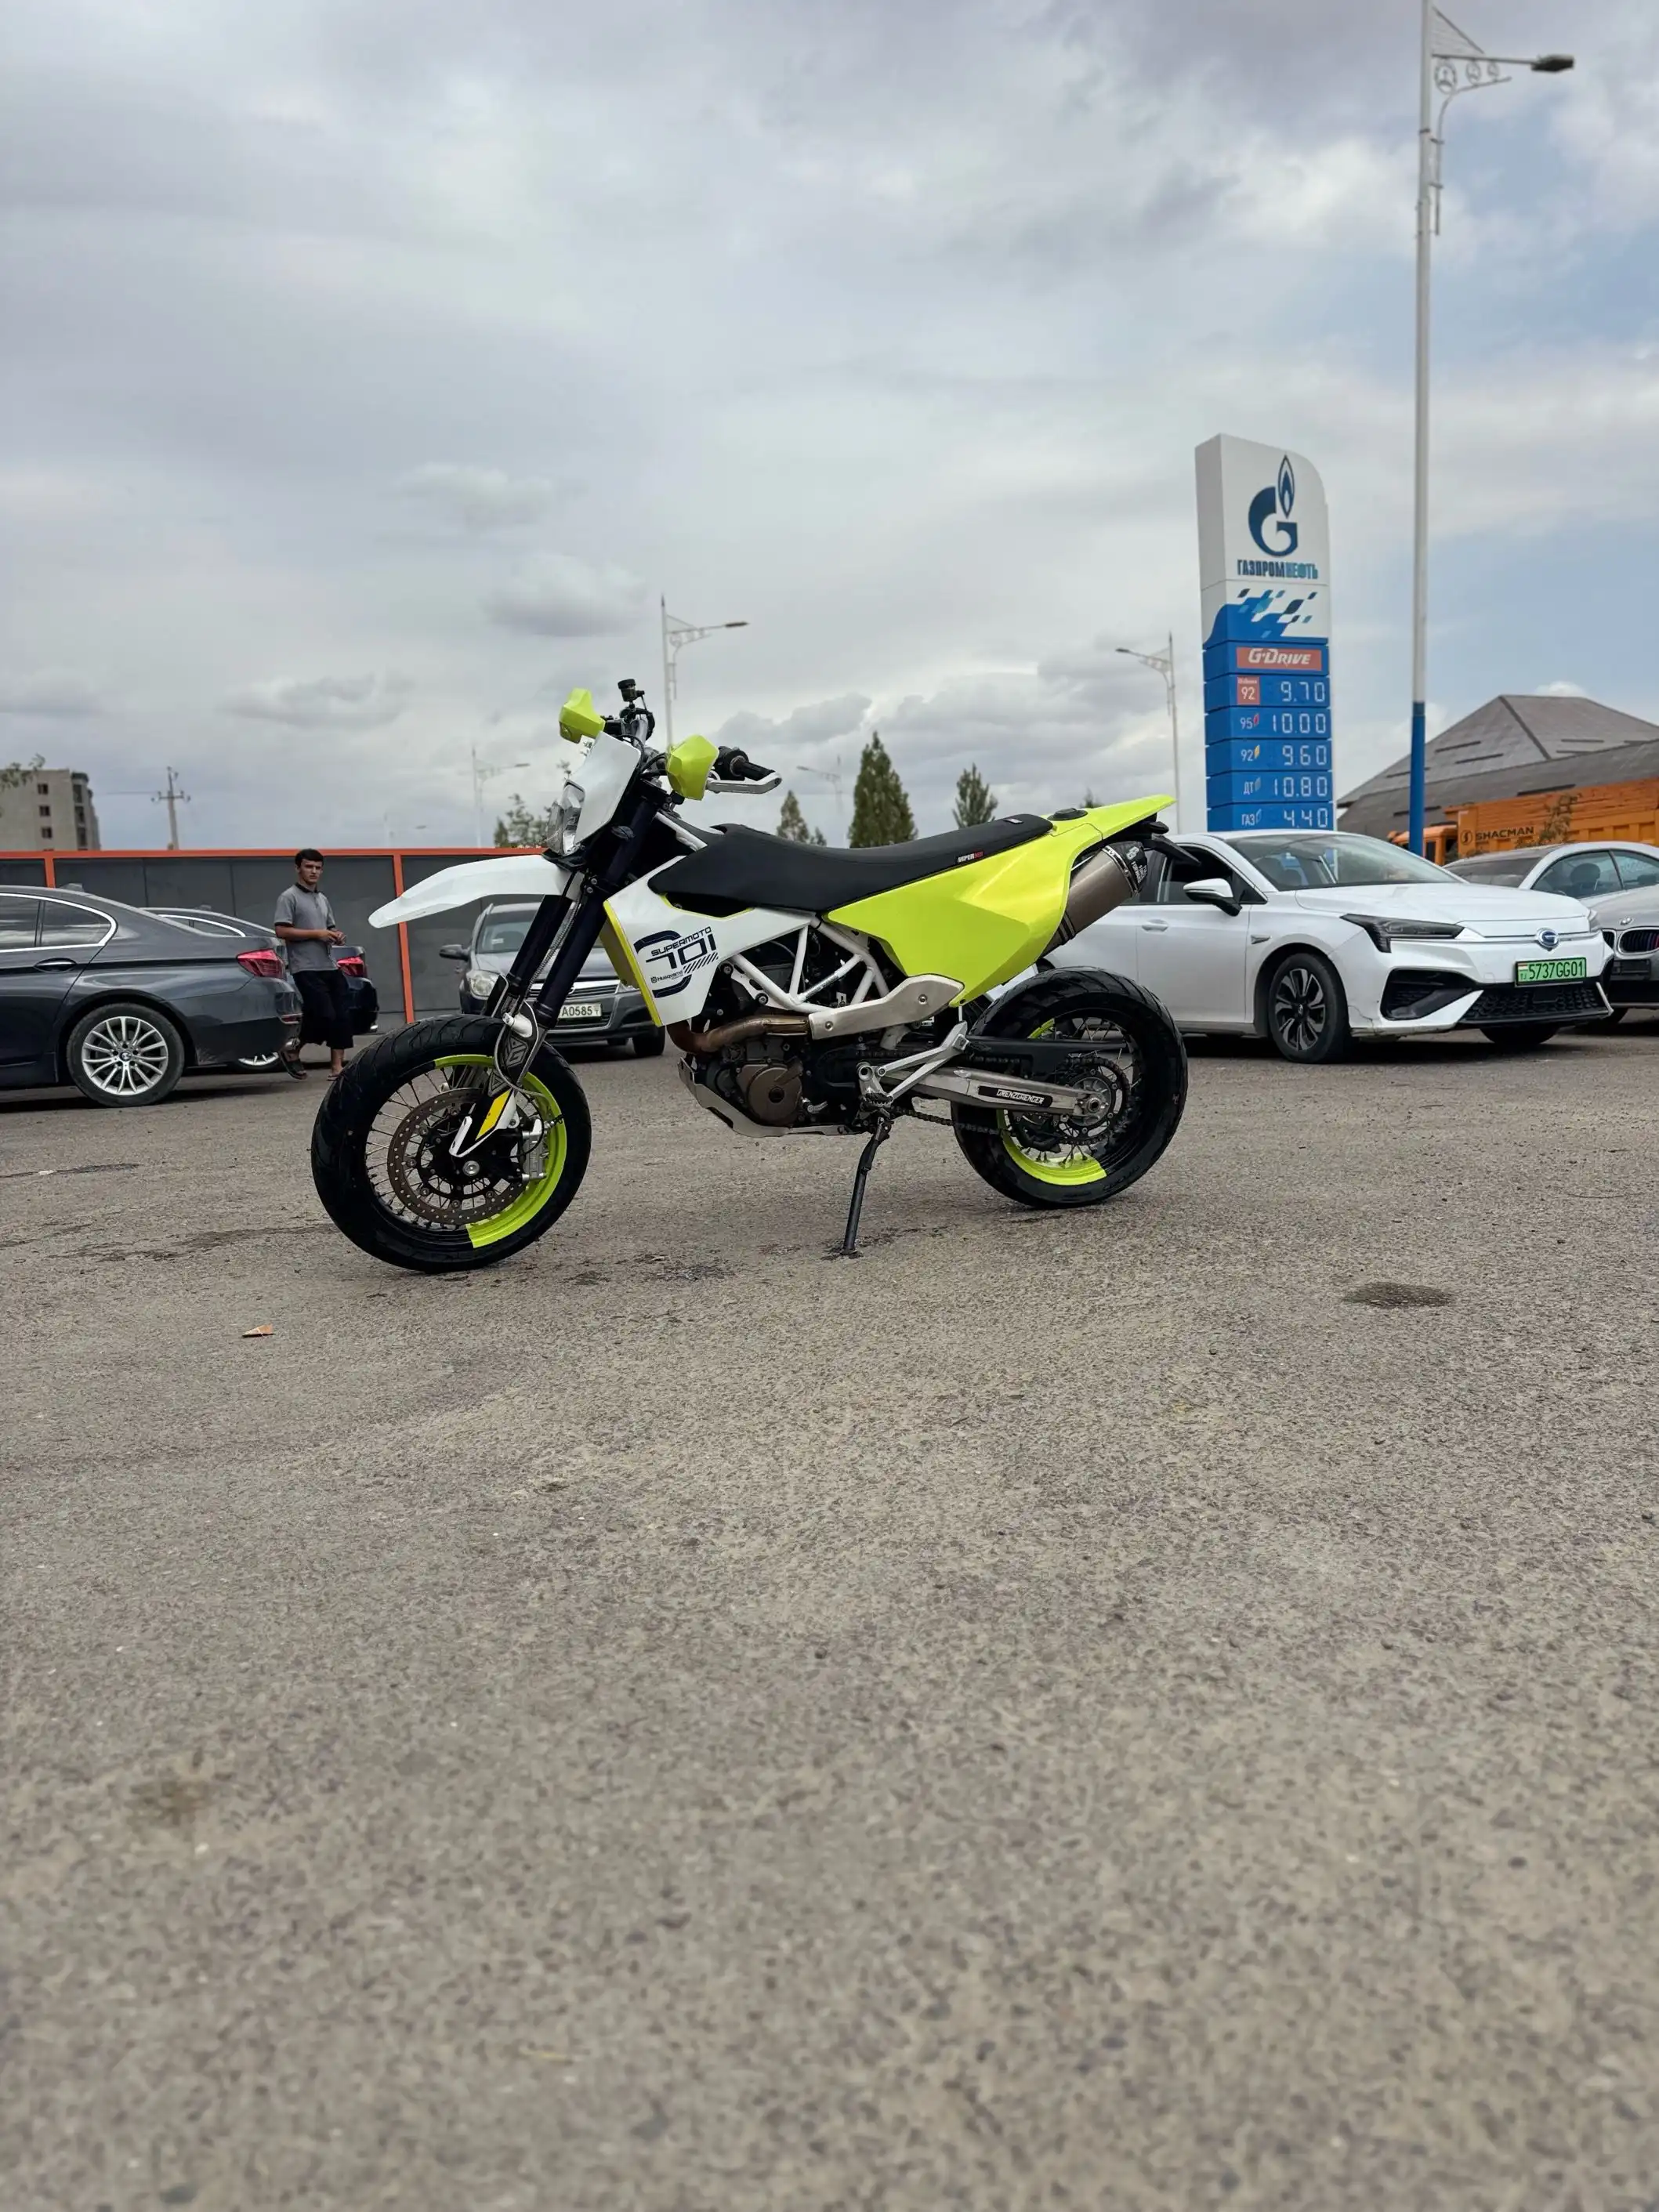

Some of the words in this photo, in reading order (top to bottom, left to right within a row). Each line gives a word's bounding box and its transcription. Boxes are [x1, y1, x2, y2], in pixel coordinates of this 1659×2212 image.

[1241, 686, 1255, 701] 92
[1240, 717, 1253, 729] 95
[1241, 749, 1254, 762] 92
[1243, 781, 1253, 795] ДТ
[1241, 813, 1255, 826] ГАЗ
[1476, 827, 1534, 840] SHACMAN
[650, 926, 712, 956] SUPERMOTO
[646, 933, 717, 969] 701
[1528, 961, 1583, 980] 5737GG01
